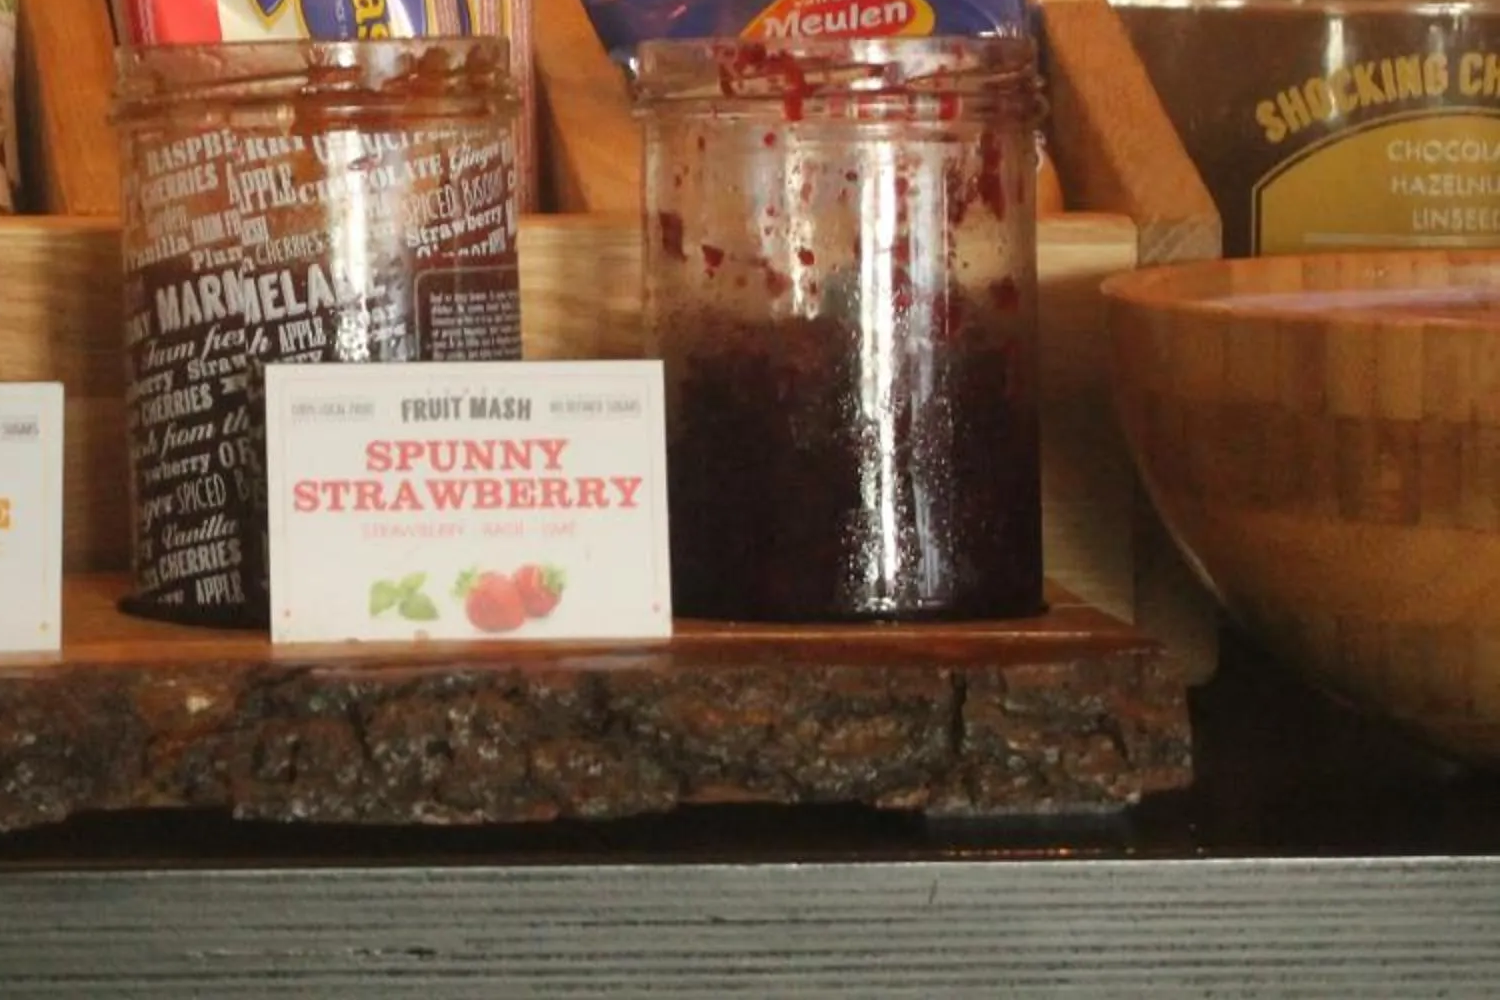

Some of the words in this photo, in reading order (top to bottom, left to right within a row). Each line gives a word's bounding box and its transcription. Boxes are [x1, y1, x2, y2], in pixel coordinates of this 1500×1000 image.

[1256, 53, 1449, 143] SHOCKING
[407, 204, 503, 249] Strawberry
[156, 262, 386, 335] MARMELA
[278, 316, 326, 353] APPLE
[141, 382, 213, 428] CHERRIES
[401, 396, 461, 423] FRUIT
[470, 396, 532, 421] MASH
[365, 438, 569, 472] SPUNNY
[177, 472, 227, 515] SPICED
[293, 477, 642, 513] STRAWBERRY
[159, 537, 242, 583] CHERRIES
